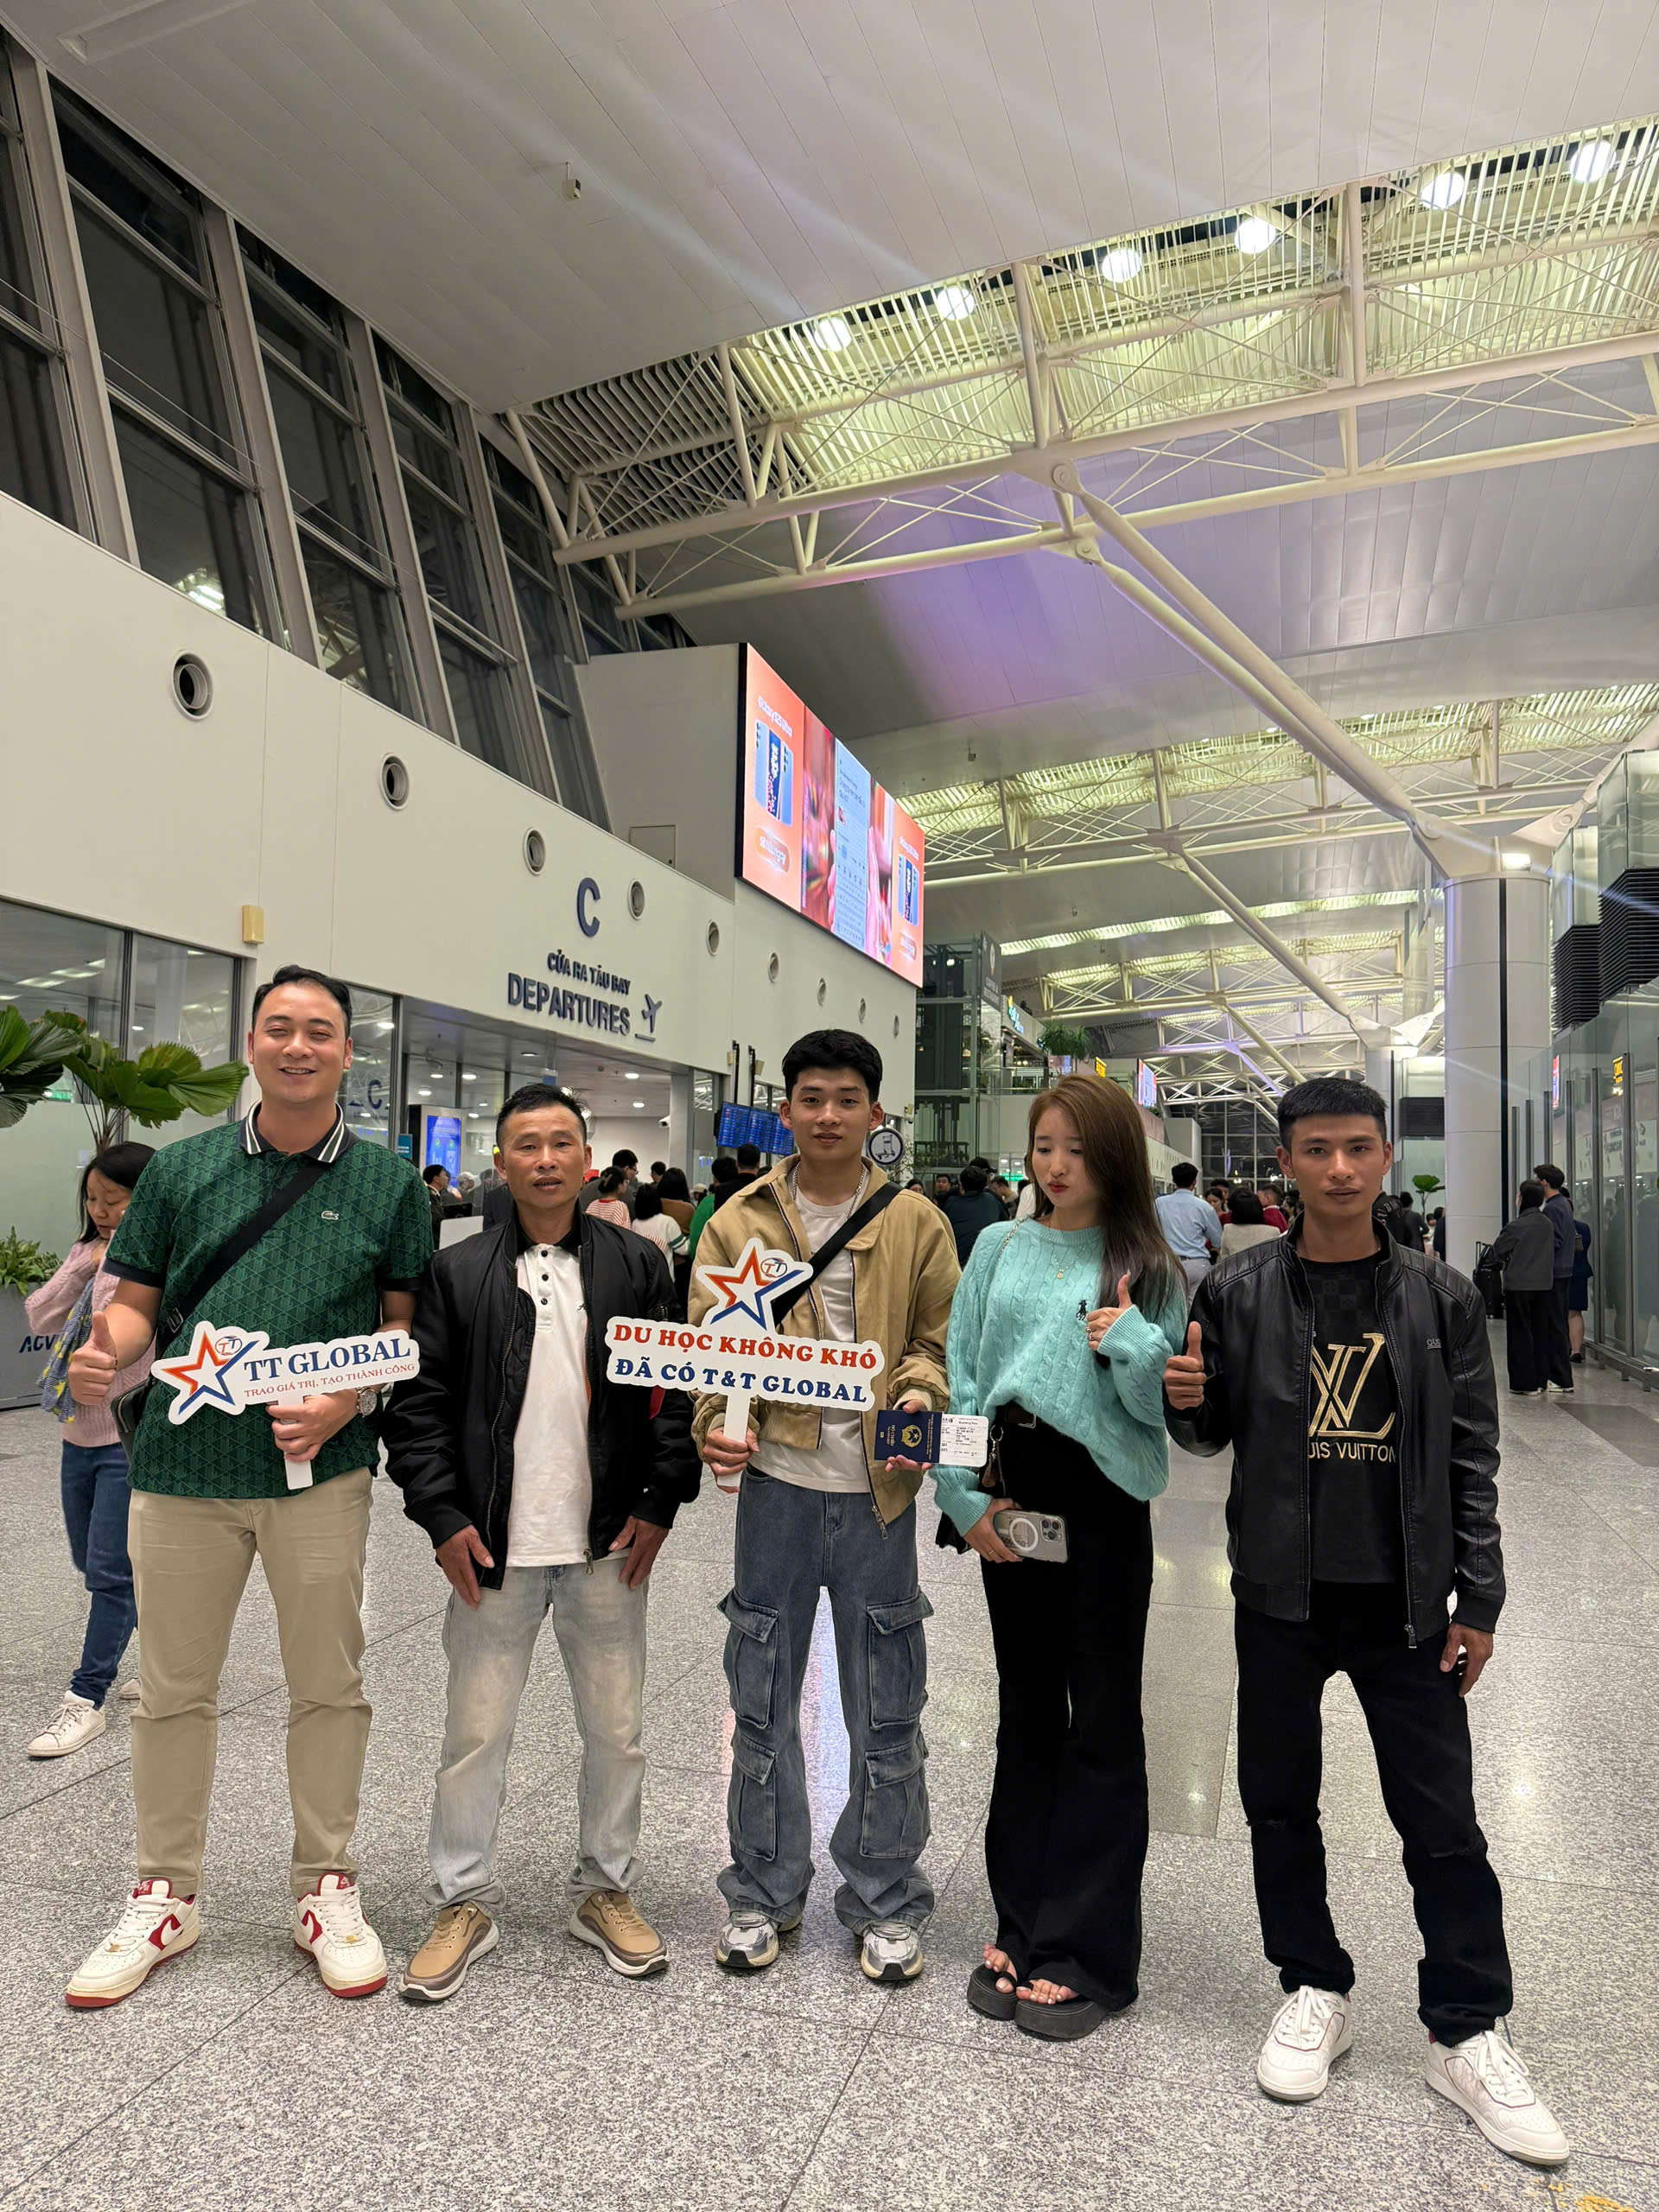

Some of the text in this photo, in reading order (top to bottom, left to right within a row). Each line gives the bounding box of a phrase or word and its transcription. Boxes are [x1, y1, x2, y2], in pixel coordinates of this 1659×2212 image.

[576, 877, 601, 938] C
[547, 949, 631, 995] CỬA RA TÀU BAY
[507, 972, 631, 1036] DEPARTURES
[244, 1338, 411, 1382] TT GLOBAL
[613, 1324, 877, 1370] DU HỌC KHÔNG KHÓ
[245, 1363, 416, 1397] TRAO GIÁ TRỊ, TẠO THÀNH CÔNG
[614, 1356, 868, 1403] ĐÃ CÓ T&T GLOBAL
